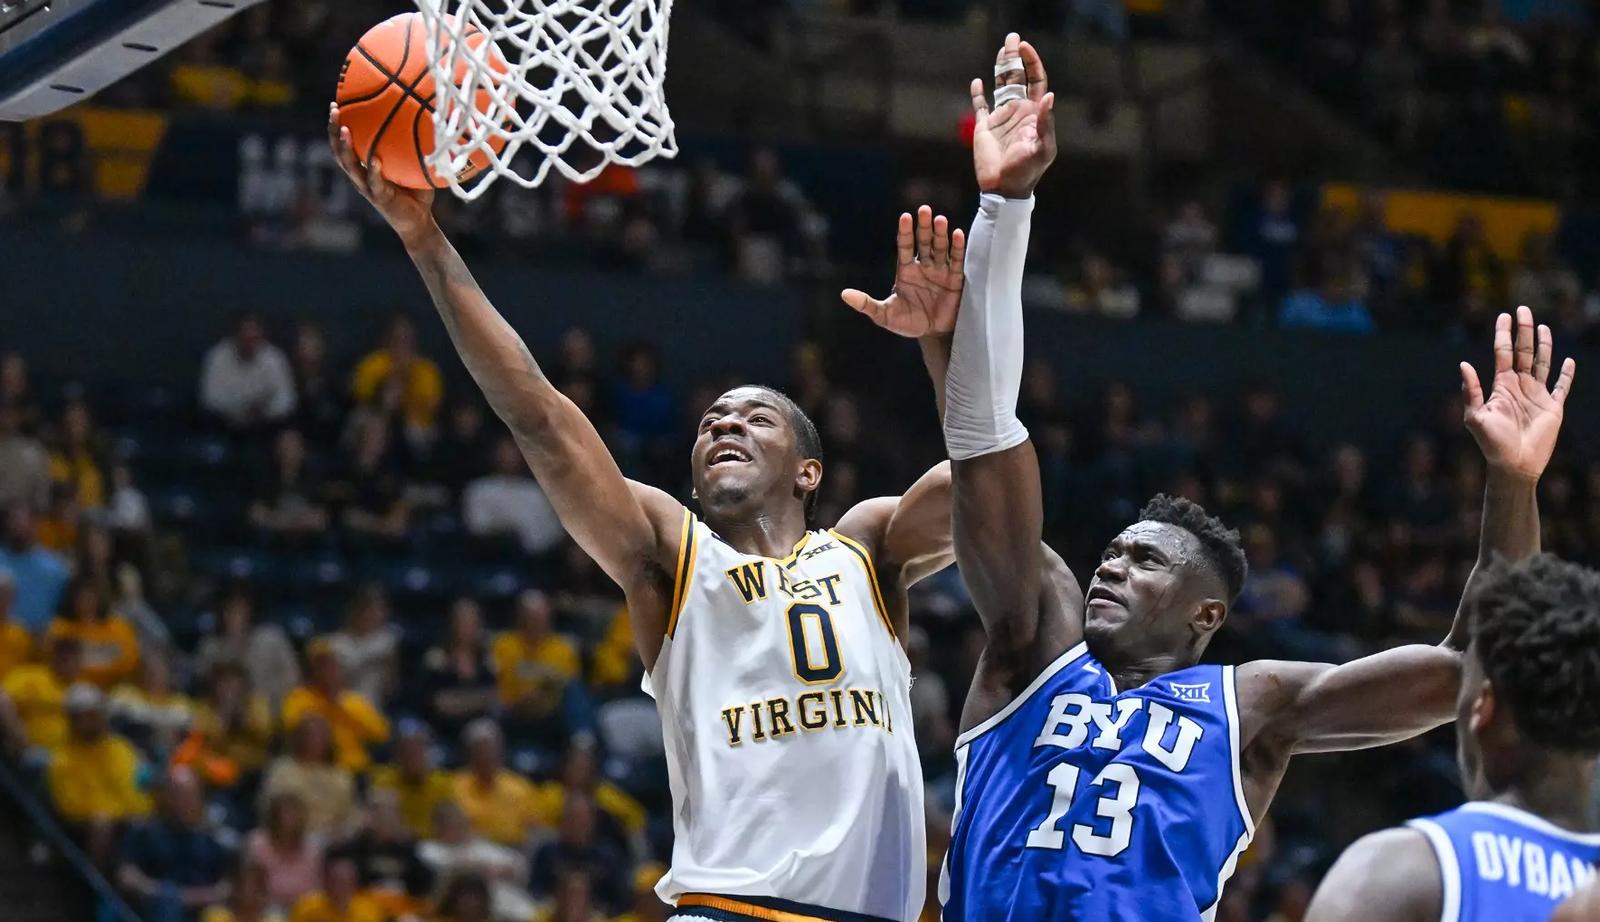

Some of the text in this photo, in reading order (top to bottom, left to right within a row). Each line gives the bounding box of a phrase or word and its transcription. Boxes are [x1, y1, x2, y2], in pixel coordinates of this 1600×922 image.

[785, 601, 846, 685] 0
[721, 688, 894, 747] VIRGINI
[1034, 693, 1203, 772] BYU
[1026, 762, 1140, 857] 13
